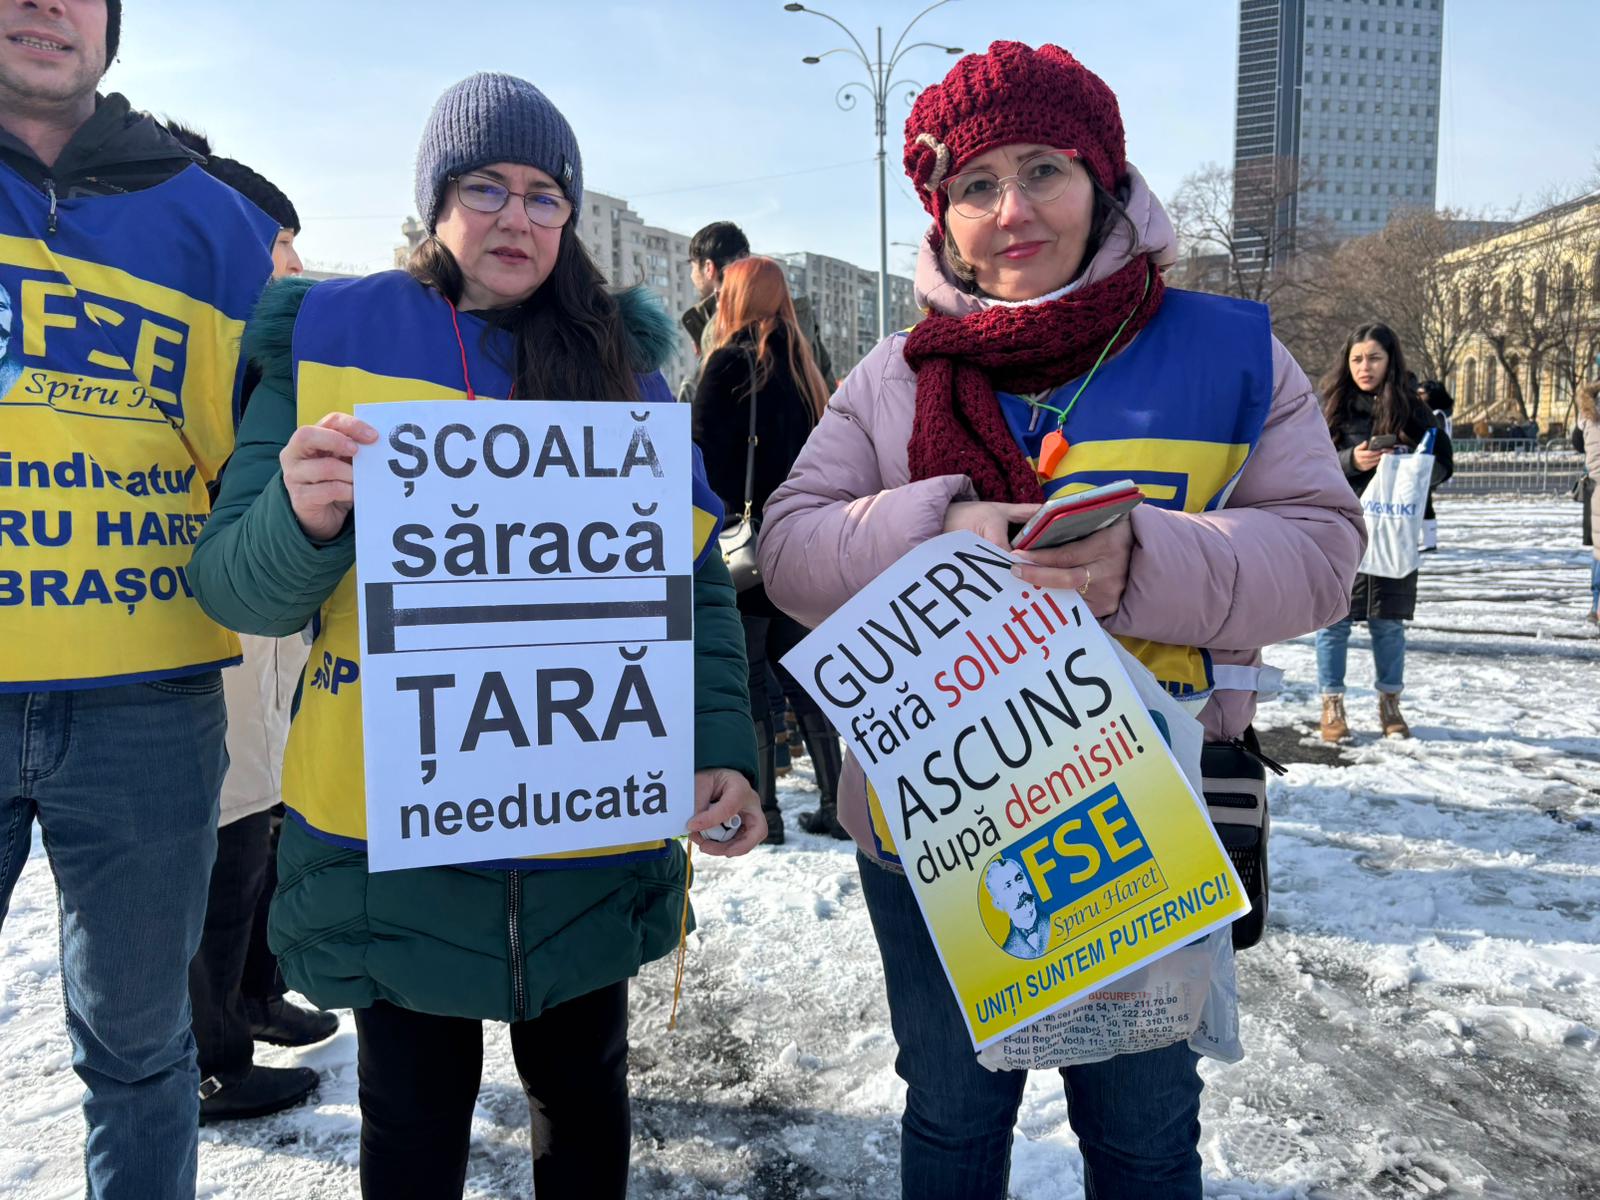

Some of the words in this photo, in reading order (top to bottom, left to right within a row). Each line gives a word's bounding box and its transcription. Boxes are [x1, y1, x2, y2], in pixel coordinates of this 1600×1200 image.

[25, 373, 119, 407] Spiru
[387, 411, 665, 498] ȘCOALĂ
[391, 502, 666, 578] săracă
[813, 543, 1015, 709] GUVERN
[850, 680, 936, 765] fără
[933, 583, 1082, 709] soluții,
[396, 645, 667, 785] ȚARĂ
[896, 647, 1113, 841] ASCUNS
[400, 769, 668, 839] needucată
[916, 804, 1001, 885] după
[1004, 713, 1145, 830] demisii!
[1019, 793, 1144, 904] FSE
[975, 981, 1023, 1024] UNIȚI
[1027, 941, 1107, 998] SUNTEM
[1110, 872, 1232, 955] PUTERNICI!
[1053, 904, 1101, 941] Spiru
[1102, 866, 1160, 912] Haret
